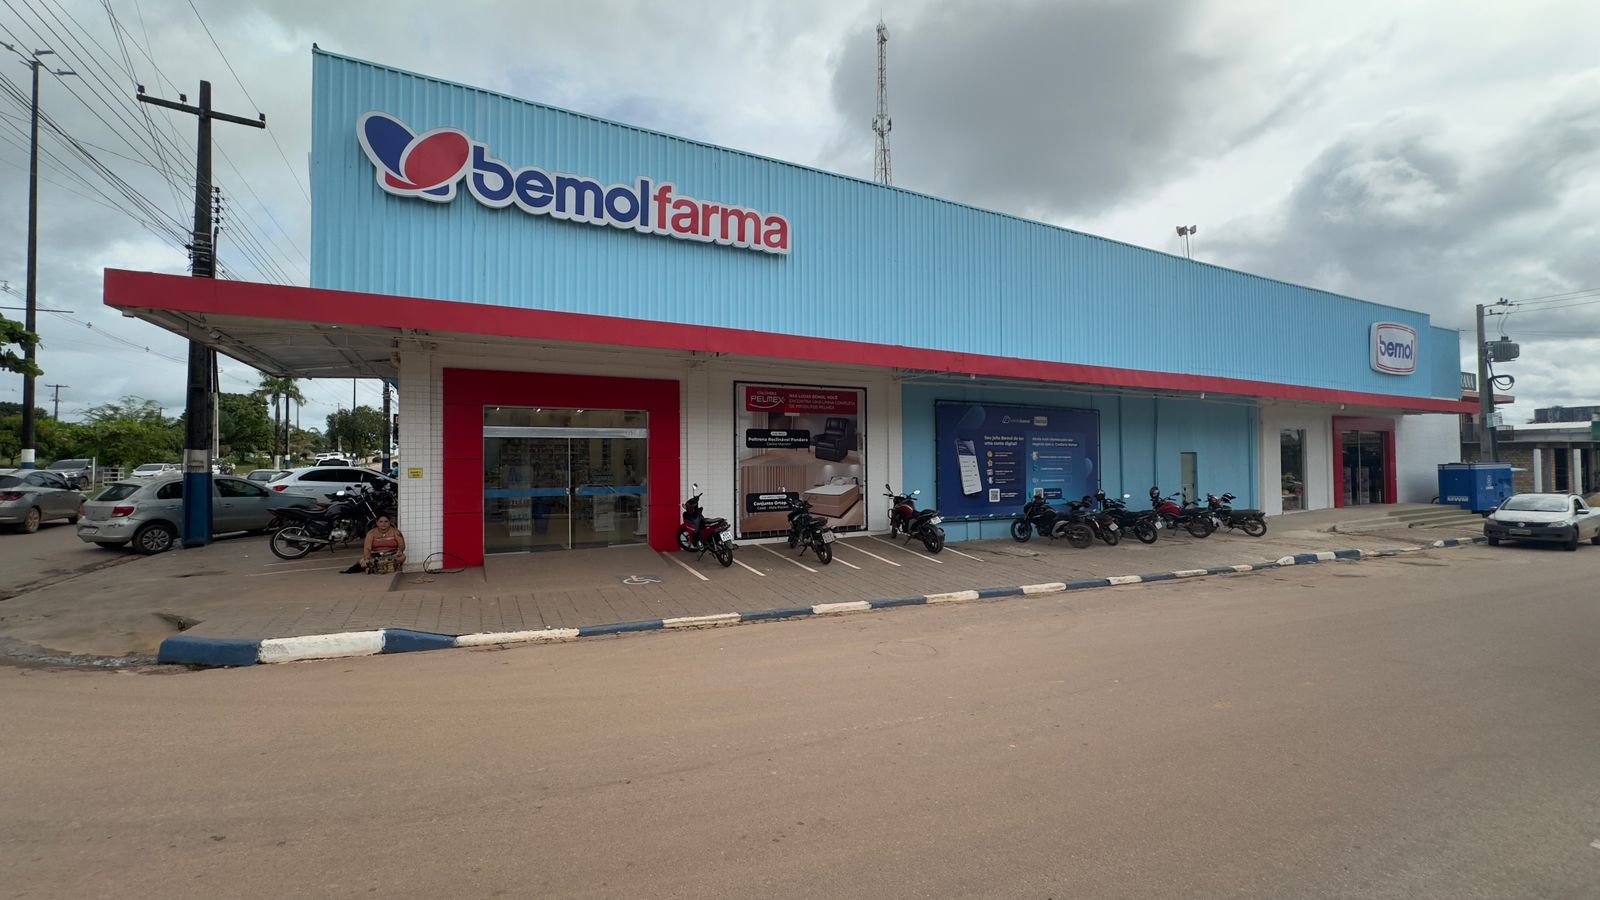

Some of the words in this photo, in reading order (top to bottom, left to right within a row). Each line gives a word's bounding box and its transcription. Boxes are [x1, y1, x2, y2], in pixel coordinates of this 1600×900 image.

[473, 145, 788, 250] bemolfarma
[1379, 334, 1413, 360] bemol
[750, 395, 785, 404] PELMEX
